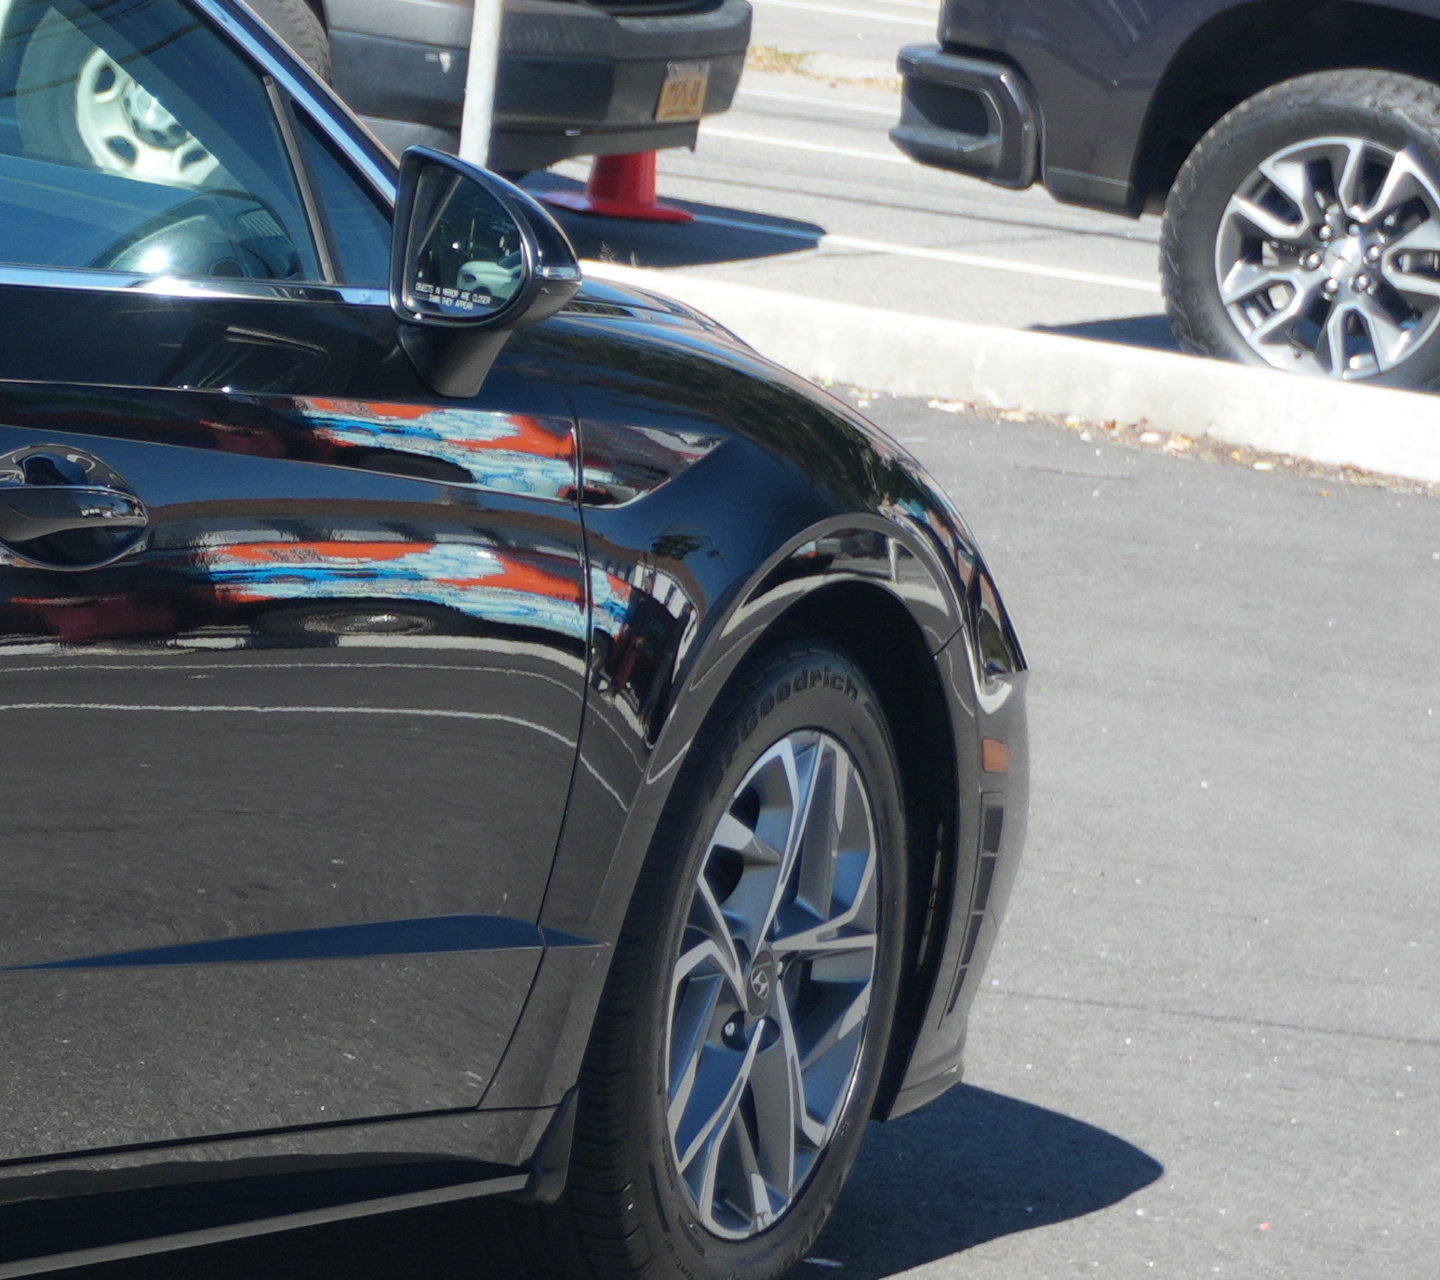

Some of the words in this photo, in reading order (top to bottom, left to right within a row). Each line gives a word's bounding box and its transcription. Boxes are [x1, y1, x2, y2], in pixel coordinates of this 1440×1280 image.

[435, 286, 440, 295] IN
[442, 287, 459, 298] MIRROR
[460, 291, 471, 301] ARE
[472, 293, 492, 305] CLOSER
[441, 296, 453, 307] THEY
[454, 300, 474, 311] APPEAR
